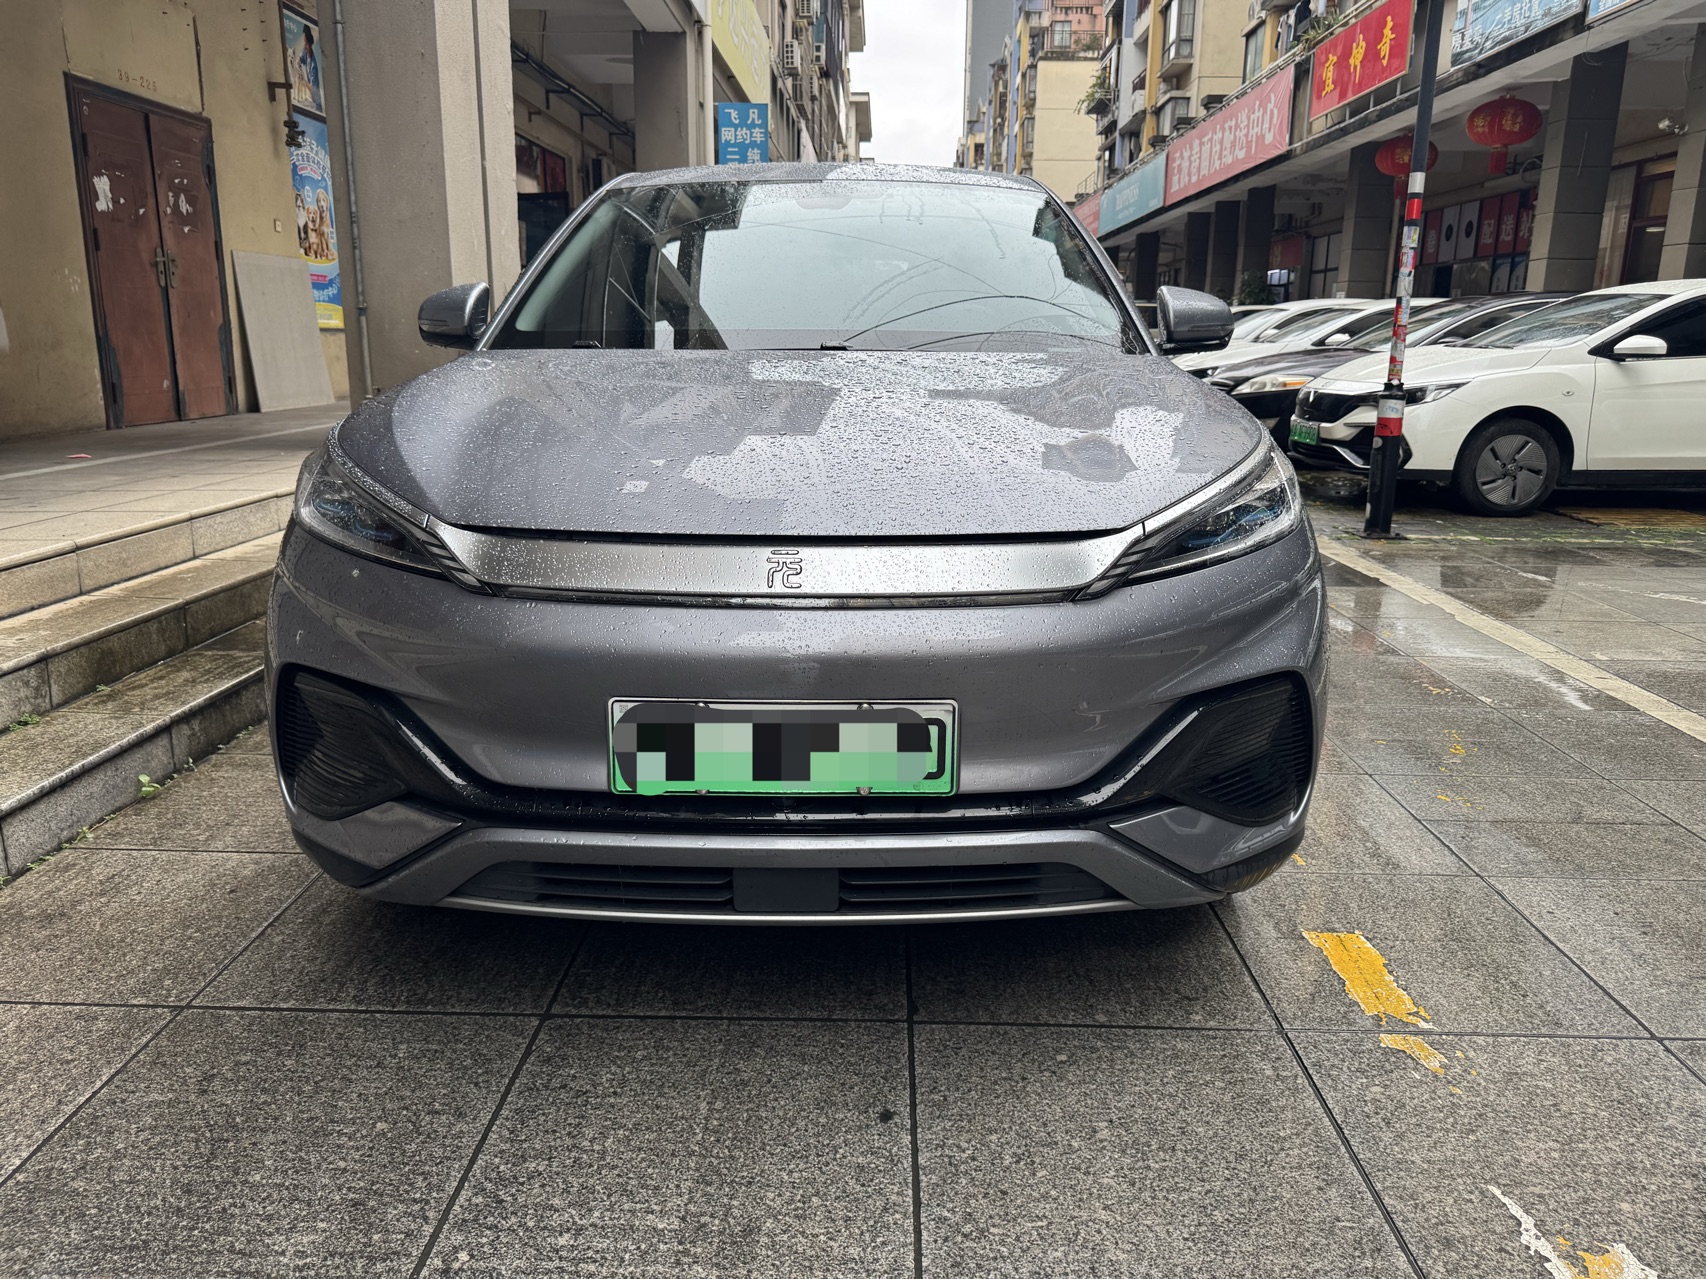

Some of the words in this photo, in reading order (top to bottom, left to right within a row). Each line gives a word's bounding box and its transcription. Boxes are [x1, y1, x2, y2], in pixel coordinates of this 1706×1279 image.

[117, 68, 157, 92] 39-225
[724, 109, 762, 125] 飞凡
[721, 127, 766, 145] 网约车
[766, 549, 803, 589] 元
